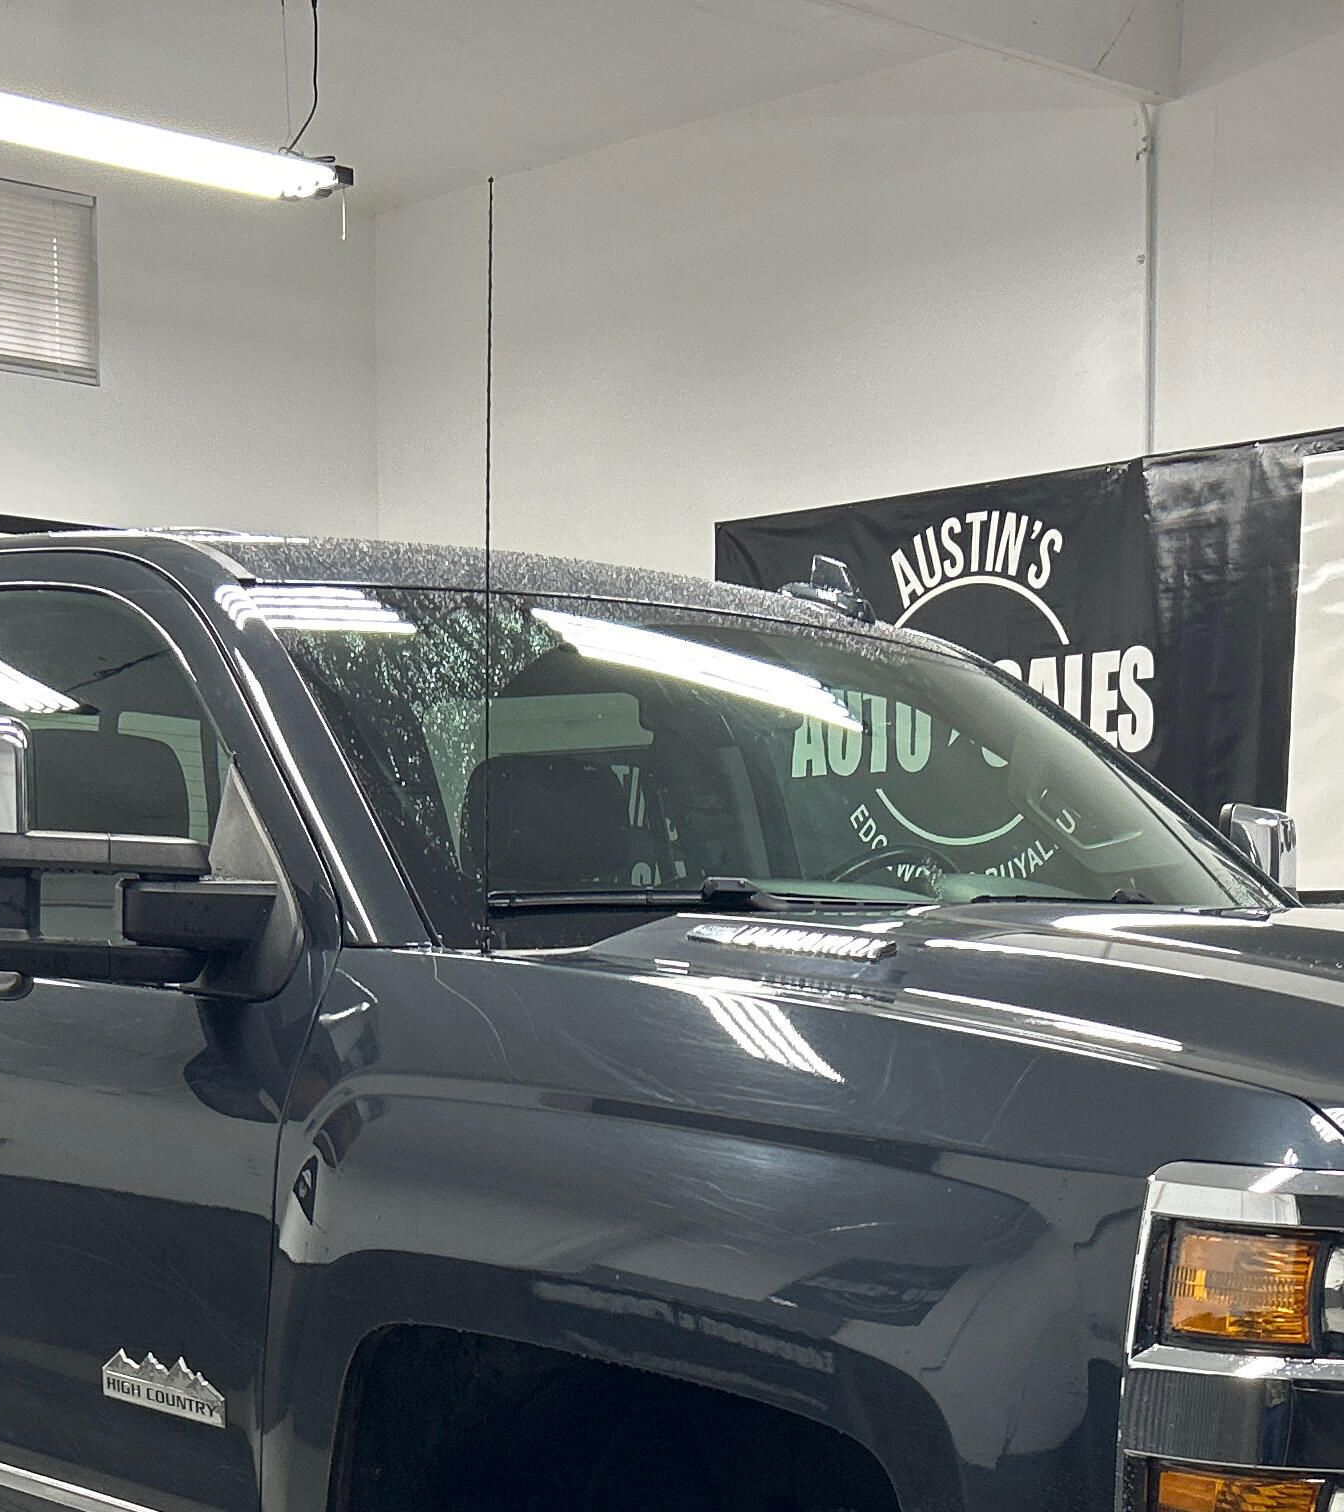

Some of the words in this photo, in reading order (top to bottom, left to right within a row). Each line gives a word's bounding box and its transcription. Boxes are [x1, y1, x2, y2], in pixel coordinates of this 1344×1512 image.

[890, 510, 1063, 609] AUSTIN'S
[993, 645, 1155, 753] LES
[106, 1376, 142, 1399] HIGH
[146, 1387, 218, 1418] COUNTRY
